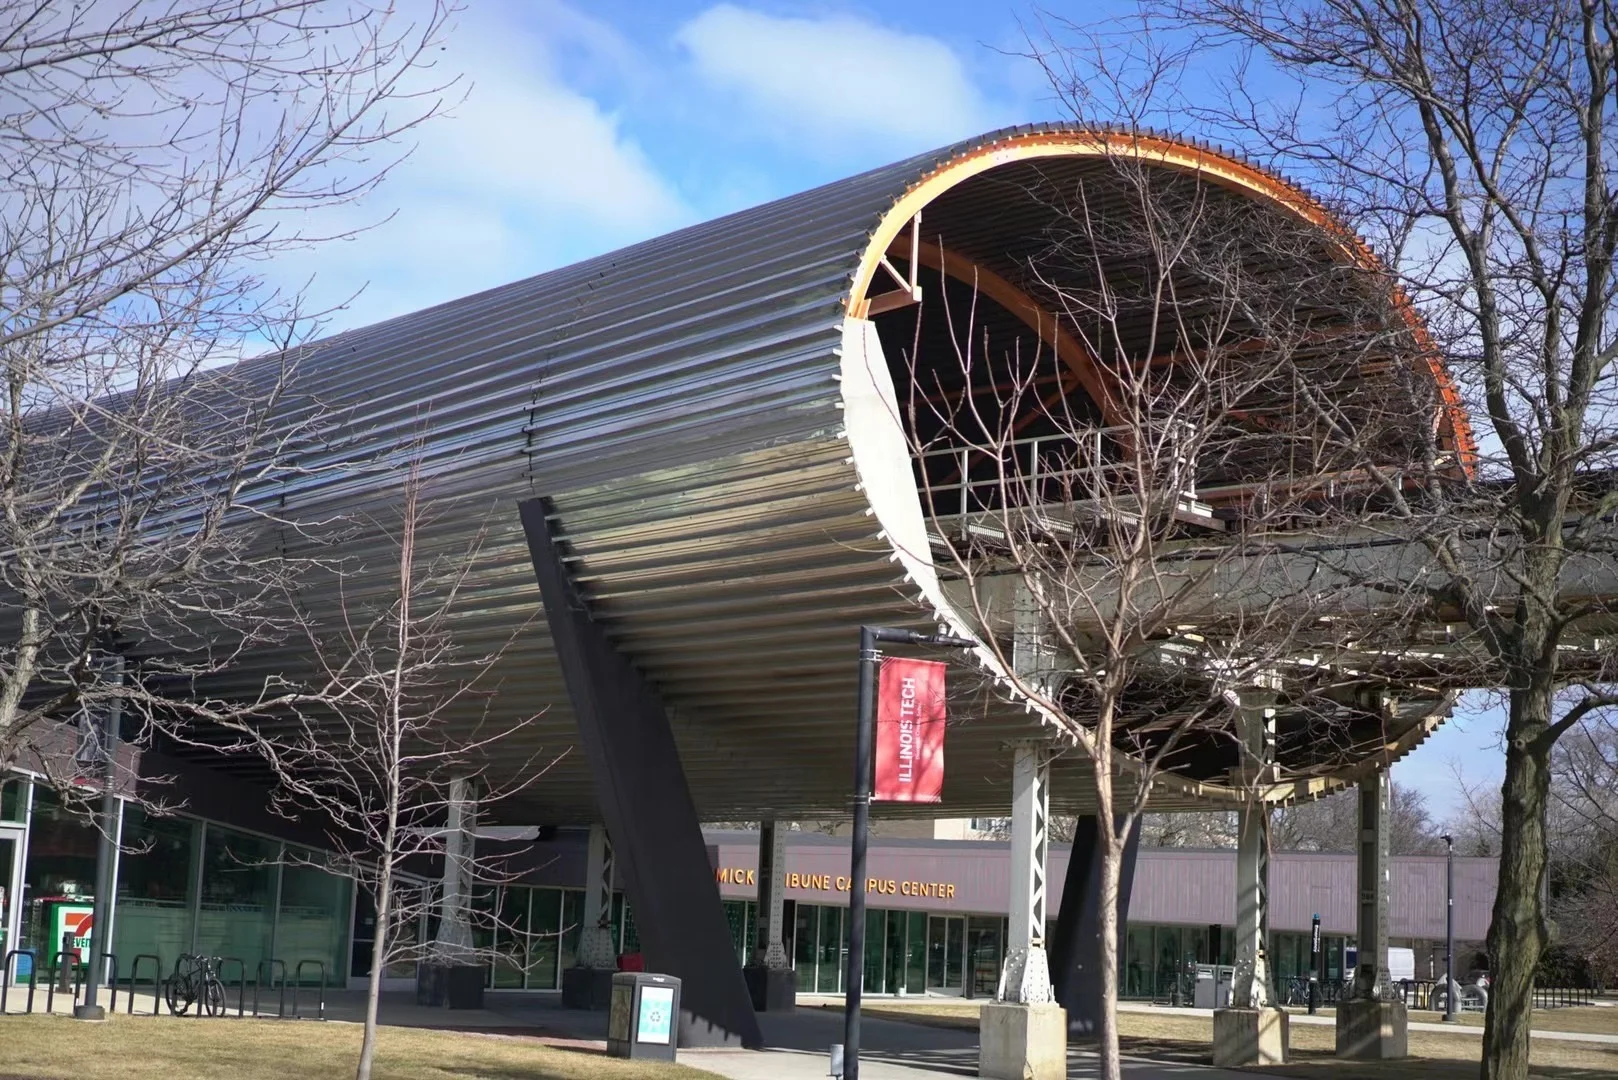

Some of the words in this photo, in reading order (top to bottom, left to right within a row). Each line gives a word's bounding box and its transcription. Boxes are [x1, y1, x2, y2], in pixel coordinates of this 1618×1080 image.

[900, 677, 916, 718] TECH
[898, 719, 913, 783] ILLINOIS
[715, 868, 755, 885] MICK
[785, 872, 831, 891] IBUNE
[835, 876, 897, 895] CAPUS
[900, 880, 955, 898] CENTER
